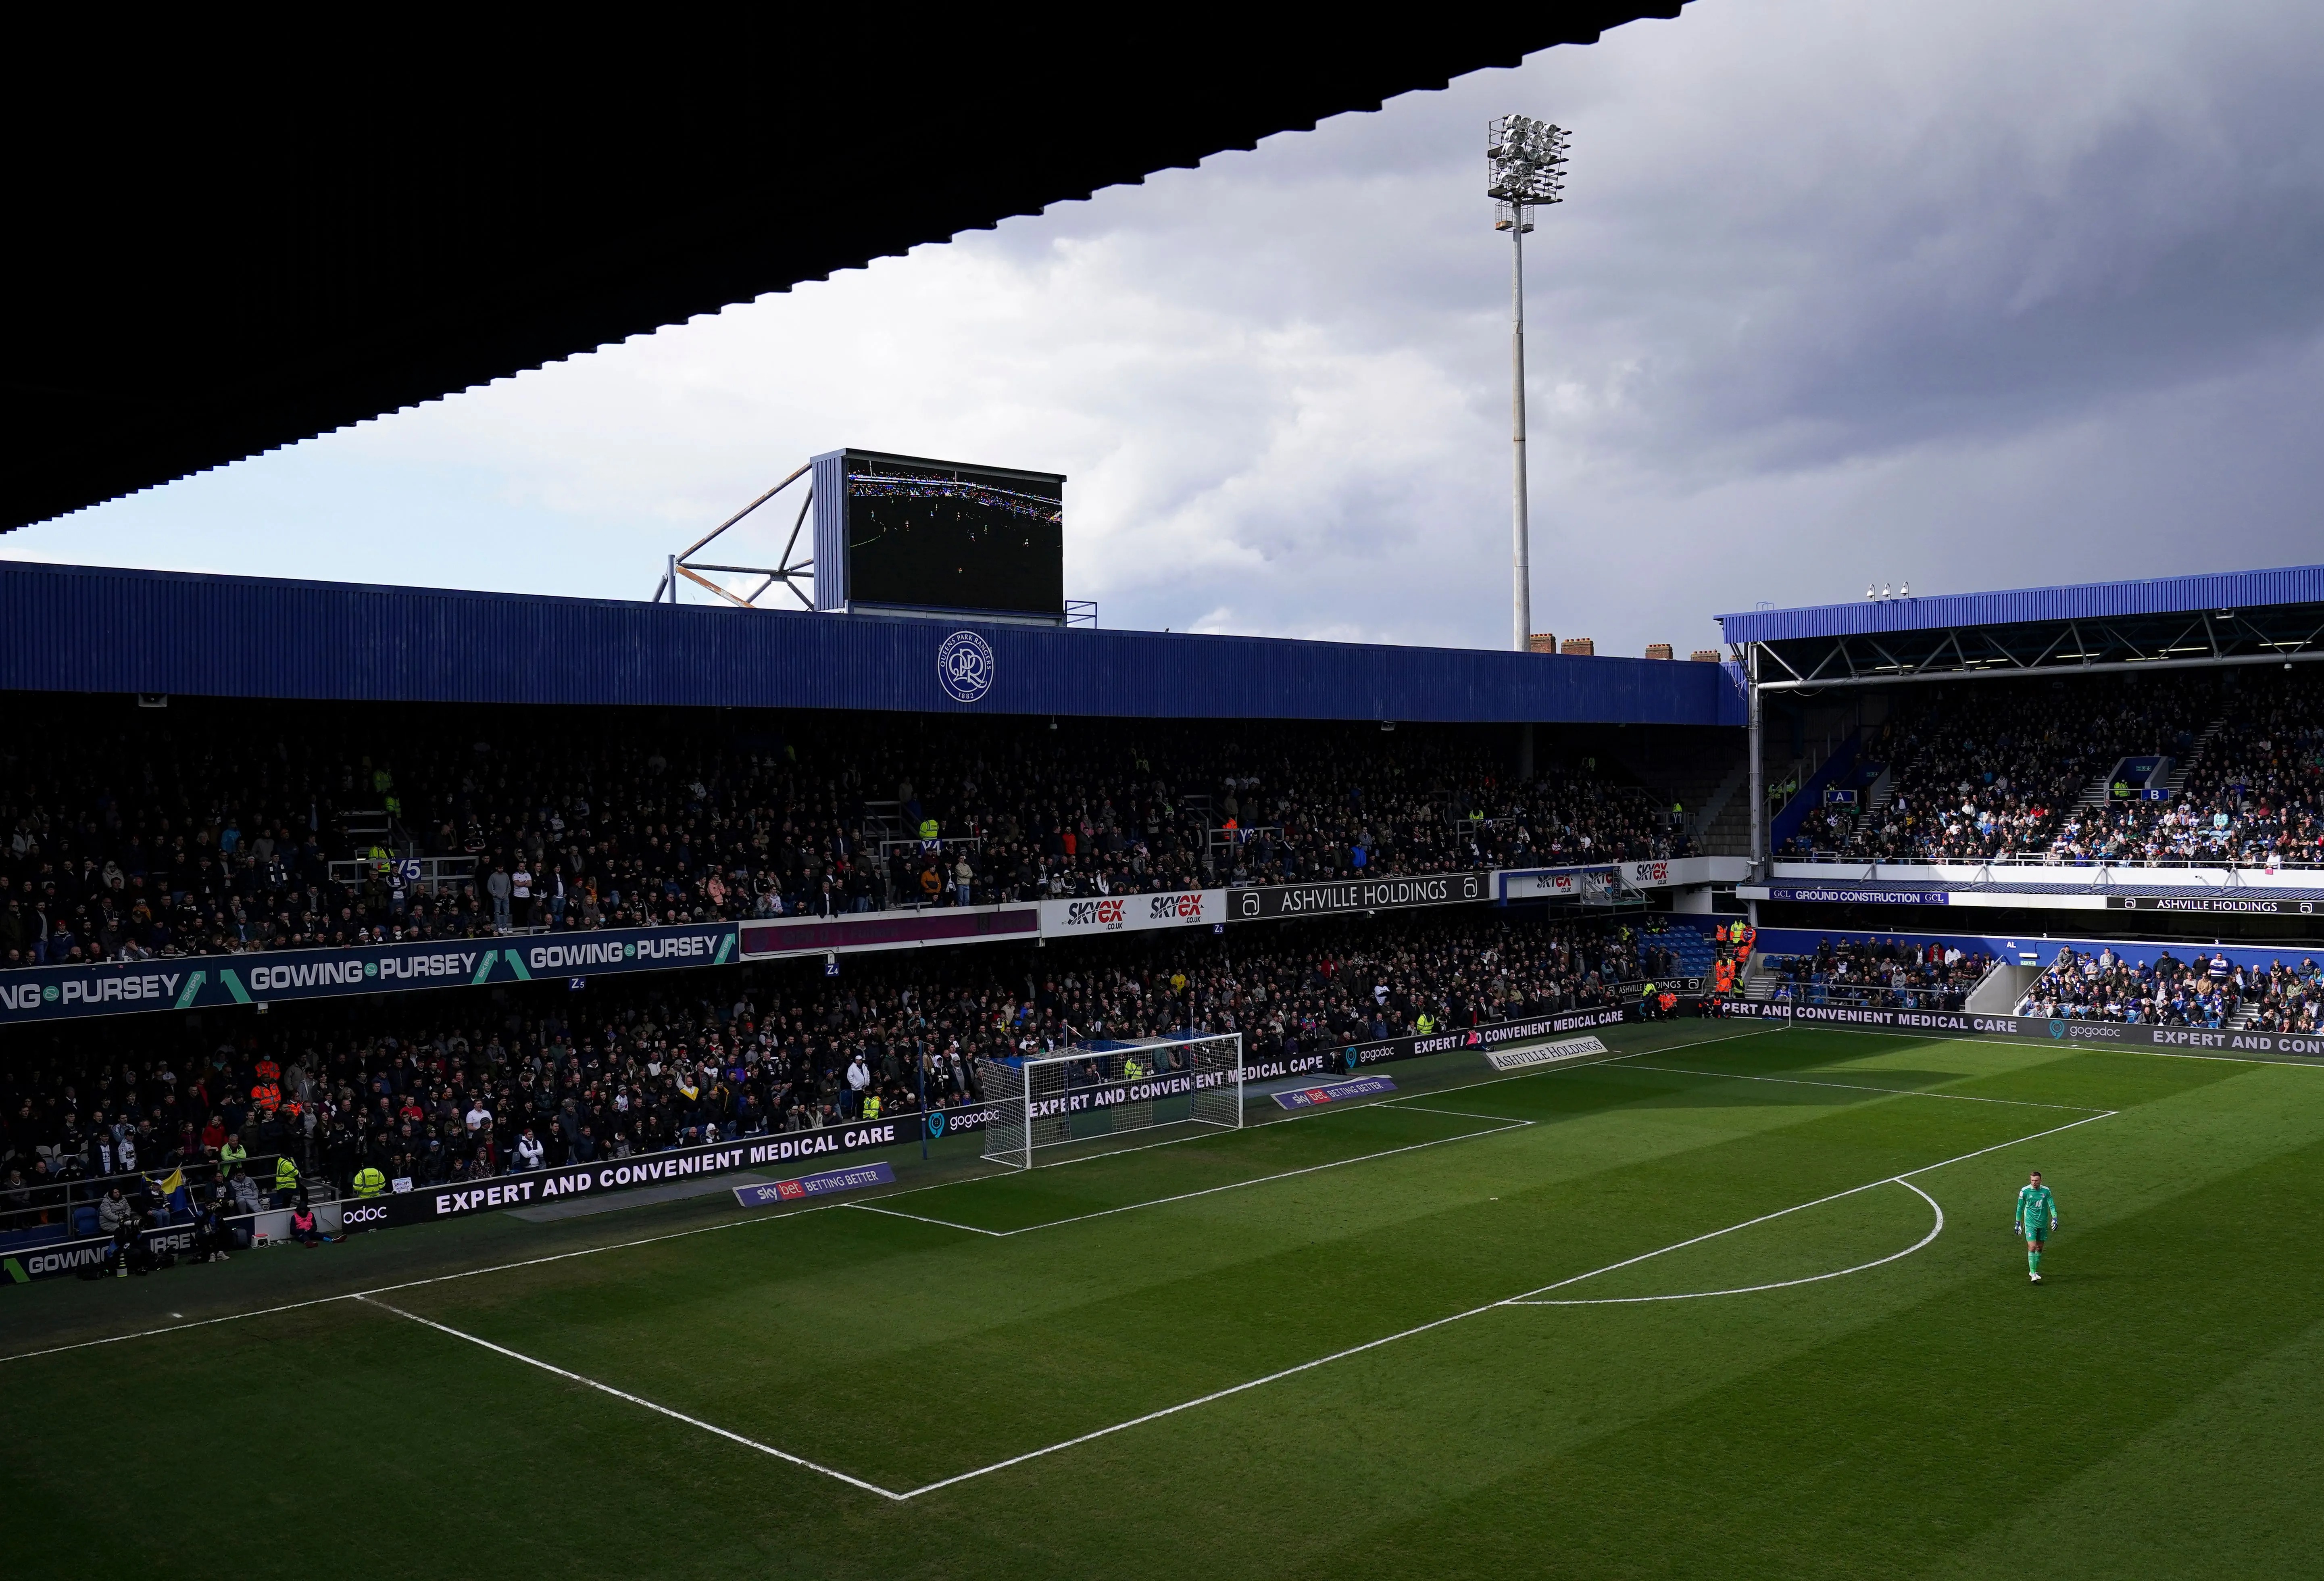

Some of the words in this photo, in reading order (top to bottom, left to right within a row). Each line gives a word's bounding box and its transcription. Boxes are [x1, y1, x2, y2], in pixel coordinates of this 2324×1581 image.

[940, 638, 956, 667] QUEENS
[974, 637, 992, 670] RANGERS
[1836, 792, 1844, 801] A
[2151, 790, 2159, 800] B
[1673, 812, 1681, 824] Y1
[1281, 886, 1358, 911] ASHVILLE
[1364, 880, 1447, 906] HOLDINGS
[1795, 891, 1838, 901] GROUND
[1840, 892, 1920, 903] CONSTRUCTION
[2157, 899, 2209, 910] ASHVILLE
[2213, 901, 2278, 911] HOLDINGS
[1106, 922, 1123, 930] .CO.UK
[1214, 924, 1223, 934] Z3
[530, 942, 623, 968] GOWING
[637, 935, 718, 959] PURSEY
[719, 935, 732, 959] SKIPS
[250, 960, 363, 991] GOWING
[380, 952, 477, 980] PURSEY
[478, 952, 493, 978] SKIPS
[827, 965, 838, 975] Z4
[62, 973, 180, 1005] PURSEY
[182, 973, 201, 1001] SKIPS
[571, 977, 585, 989] Z5
[1619, 983, 1642, 994] ASHVILLE
[1762, 1004, 1791, 1017] AND
[1795, 1006, 1894, 1025] CONVENIENT
[1898, 1013, 1968, 1030] MEDICAL
[1972, 1018, 2018, 1033] CARE
[1414, 1035, 1457, 1054] EXPERT
[1485, 1021, 1551, 1042] CONVENIENT
[1553, 1015, 1597, 1031] MEDICAL
[1599, 1010, 1624, 1024] CARE
[2069, 1025, 2121, 1038] gogodoc
[2153, 1030, 2225, 1047] EXPERT
[2231, 1035, 2272, 1050] AND
[1360, 1046, 1394, 1063] gogodoc
[1496, 1050, 1547, 1067] ASHVILLE
[1550, 1040, 1603, 1057] HOLDINGS
[1030, 1093, 1089, 1118] EXPERT
[1094, 1089, 1126, 1107] AND
[1228, 1062, 1286, 1083] MEDICAL
[1292, 1094, 1311, 1105] sky
[1307, 1089, 1328, 1101] bet
[1327, 1085, 1357, 1097] BETTING
[1357, 1082, 1384, 1093] BETTER
[950, 1109, 1000, 1130] gogodoc
[436, 1181, 535, 1214] EXPERT
[542, 1173, 592, 1197] AND
[599, 1149, 744, 1187] CONVENIENT
[750, 1135, 838, 1164] MEDICAL
[844, 1125, 895, 1148] CARE
[757, 1187, 777, 1202] sky
[779, 1180, 802, 1196] bet
[805, 1175, 845, 1192] BETTING
[845, 1171, 879, 1186] BETTER
[343, 1205, 388, 1224] odoc
